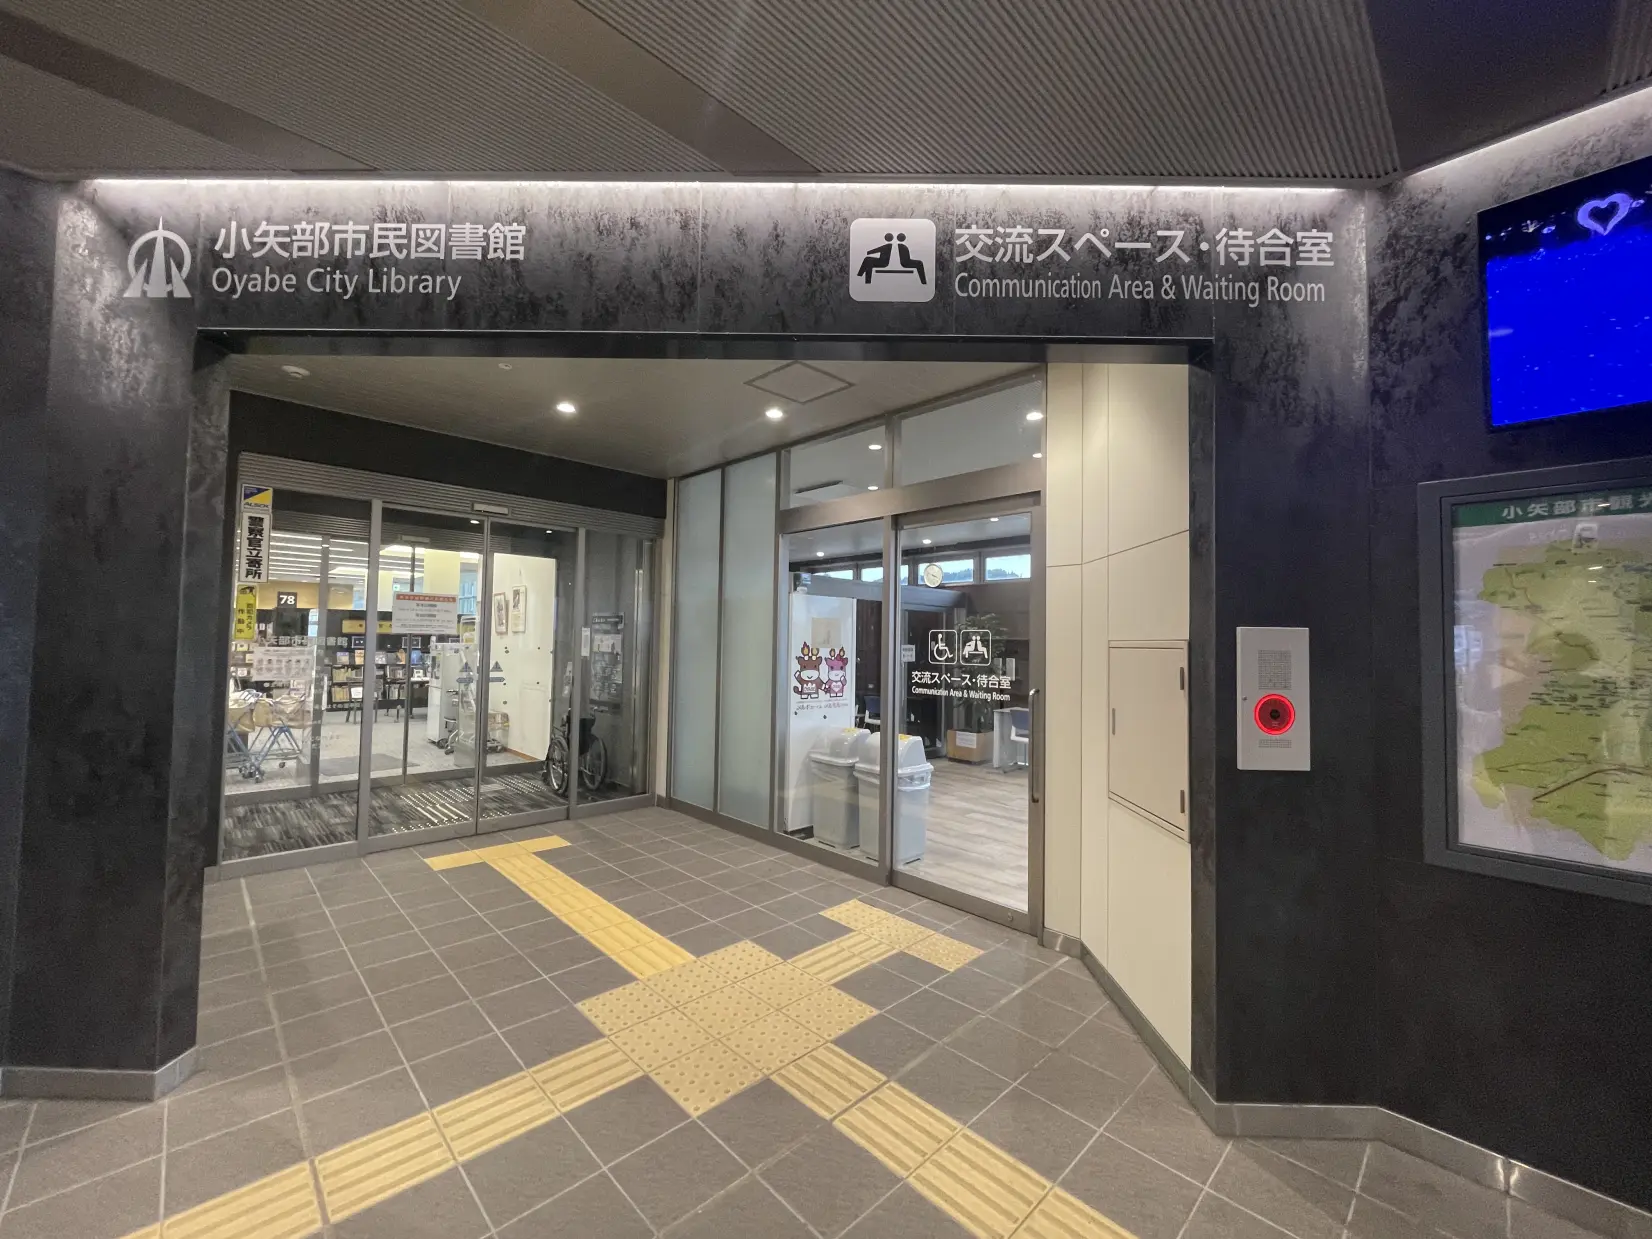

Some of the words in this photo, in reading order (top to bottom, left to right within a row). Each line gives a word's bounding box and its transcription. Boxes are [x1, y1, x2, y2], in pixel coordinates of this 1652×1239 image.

[214, 221, 526, 261] 小矢部市民図書館
[954, 225, 1334, 267] 交流スペース・待合室
[212, 267, 297, 299] Oyabe
[306, 267, 359, 299] City
[369, 268, 462, 299] Library
[954, 272, 1101, 300] Communication
[1108, 276, 1155, 300] Area
[1160, 275, 1177, 301] &
[1181, 274, 1260, 308] Waiting
[1267, 278, 1326, 302] Room
[279, 595, 295, 604] 78
[911, 671, 1012, 689] 交流スペース・待合室
[911, 686, 949, 696] Communication
[949, 689, 962, 697] Area
[969, 690, 991, 702] Waiting
[992, 692, 1011, 701] Room
